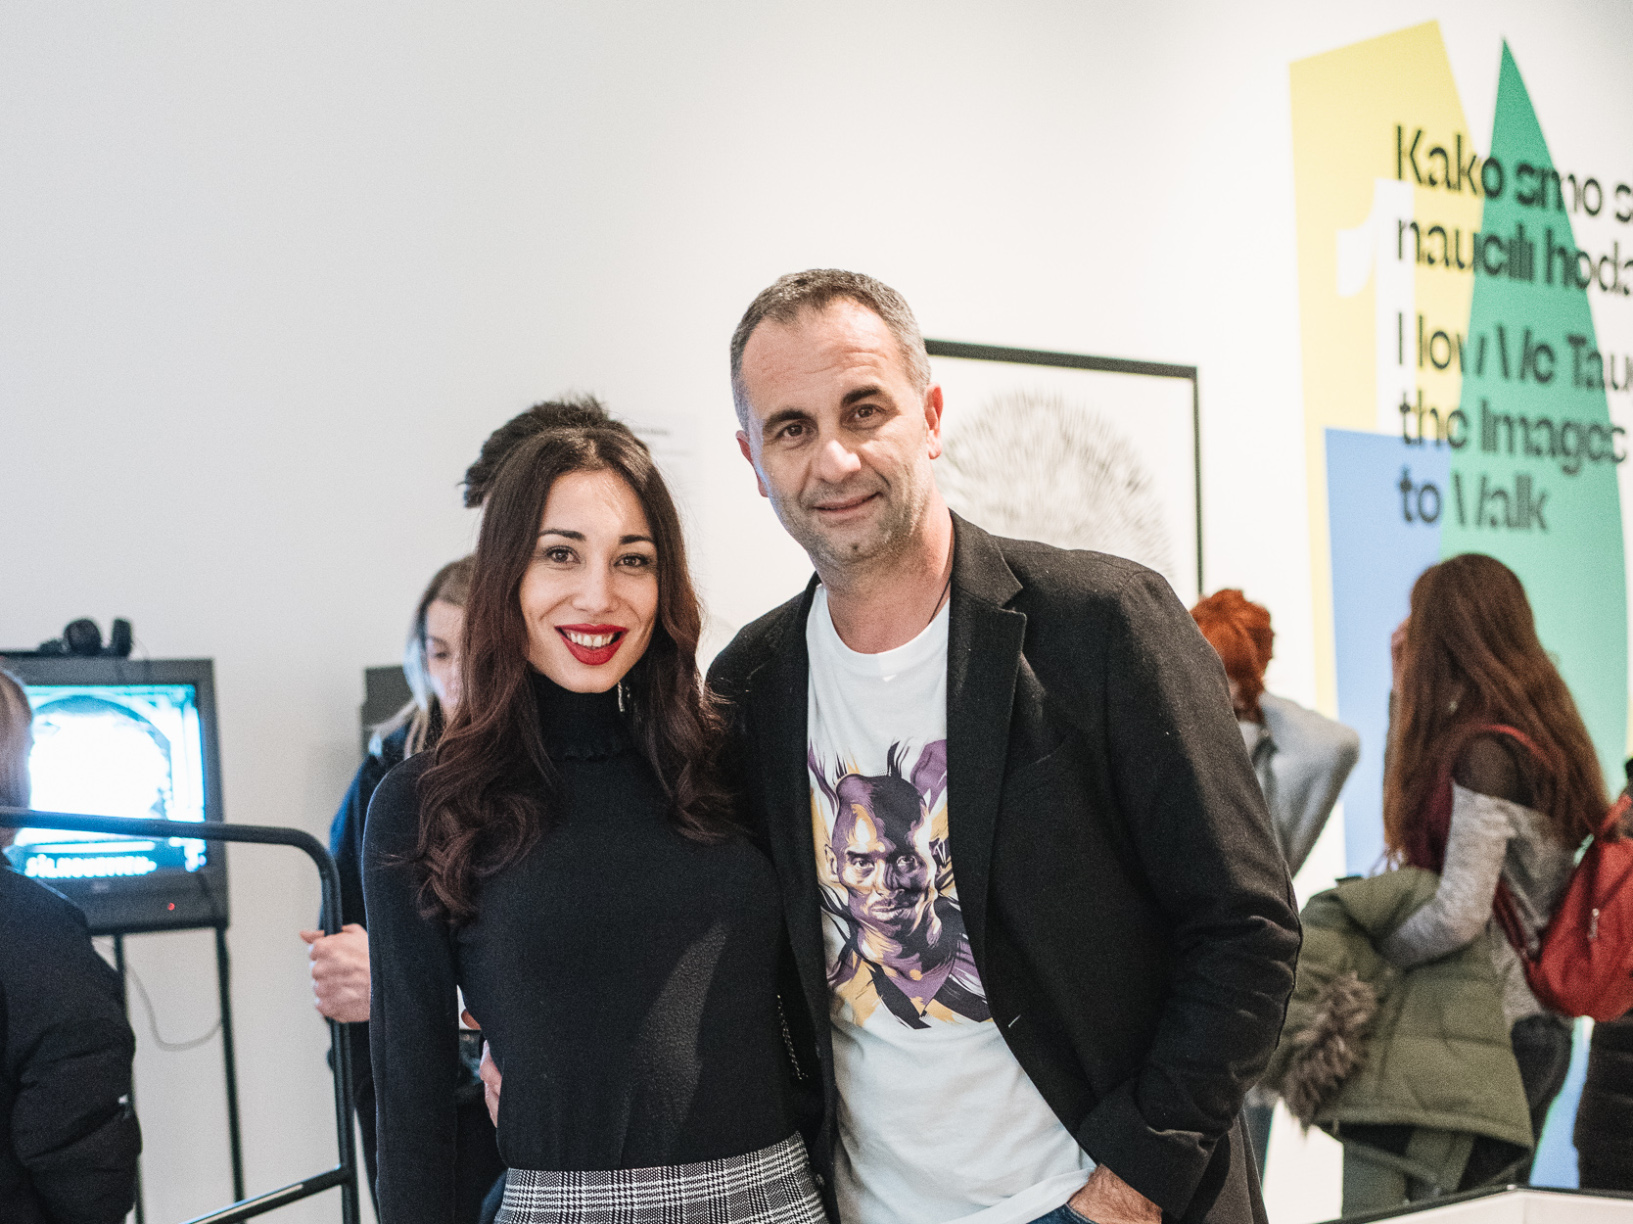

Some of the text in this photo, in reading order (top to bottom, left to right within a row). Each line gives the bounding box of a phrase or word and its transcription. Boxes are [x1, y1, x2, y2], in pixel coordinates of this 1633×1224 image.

[1395, 123, 1505, 202] Kako
[1514, 161, 1605, 218] smo
[1398, 387, 1628, 477] the Images
[1398, 465, 1550, 533] to Walk
